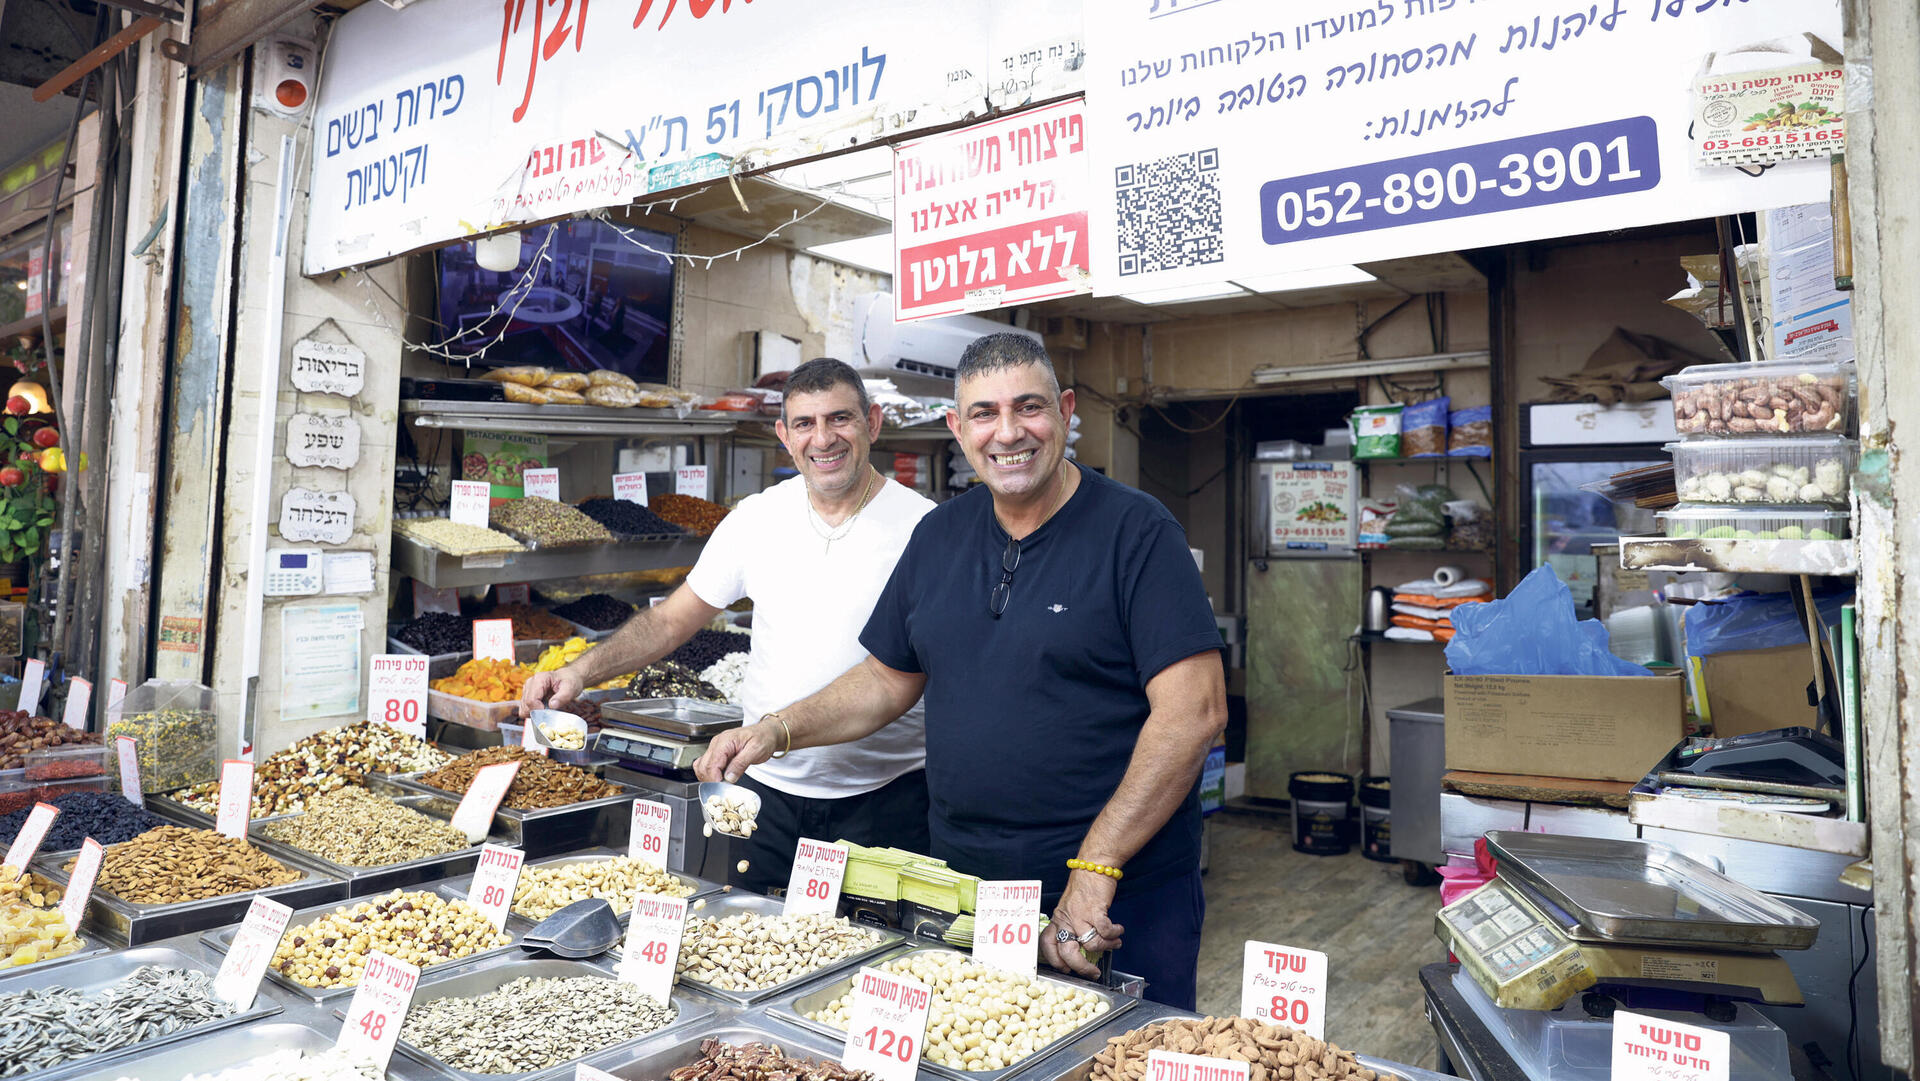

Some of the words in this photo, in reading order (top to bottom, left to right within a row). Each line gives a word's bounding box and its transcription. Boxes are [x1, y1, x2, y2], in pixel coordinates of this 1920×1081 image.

[1180, 31, 1284, 72] הלקוחות
[1325, 33, 1477, 91] מהסחורה
[1121, 58, 1172, 87] שלנו
[1742, 76, 1782, 89] משה
[1788, 69, 1843, 83] פיצוחי
[393, 74, 465, 133] פירות
[758, 46, 886, 140] לוינסקי
[1218, 72, 1306, 114] הטובה
[1812, 88, 1835, 96] חינם
[1126, 96, 1201, 132] ביותר
[1363, 77, 1519, 140] להזמנות:
[327, 99, 384, 158] יבשים
[705, 99, 741, 145] 51
[1009, 113, 1084, 167] פיצוחי
[1703, 129, 1844, 151] 03-6815165
[344, 143, 429, 211] וקיטניות
[1275, 134, 1641, 232] 052-890-3901
[911, 197, 978, 233] אצלנו
[1006, 225, 1078, 278] ללא
[910, 244, 997, 302] גלוטן
[297, 356, 360, 378] בריאות
[304, 432, 344, 449] שפע
[466, 430, 506, 441] PISTACHIO
[508, 434, 543, 445] KERNELS
[289, 504, 347, 526] הצלחה
[374, 659, 402, 671] פירות
[405, 658, 425, 671] סלט
[385, 698, 419, 723] 80
[635, 803, 650, 817] ענק
[651, 805, 669, 823] קשיו
[643, 833, 661, 853] 80
[798, 843, 815, 860] ענק
[815, 847, 845, 864] פיסטוק
[480, 849, 519, 870] בונדוק
[482, 885, 505, 908] 80
[806, 878, 830, 900] 80
[1003, 886, 1039, 903] מקדמיה
[988, 923, 1031, 944] 160
[641, 940, 668, 965] 48
[1263, 950, 1307, 974] שקד
[364, 957, 385, 980] לבן
[386, 965, 416, 993] גרעיני
[861, 974, 899, 1001] משובח
[898, 985, 928, 1013] פקאן
[1270, 995, 1309, 1025] 80
[360, 1009, 387, 1041] 48
[865, 1026, 914, 1063] 120
[1640, 1024, 1701, 1052] סושי
[1624, 1042, 1668, 1061] מיוחד
[1673, 1053, 1710, 1071] חדש
